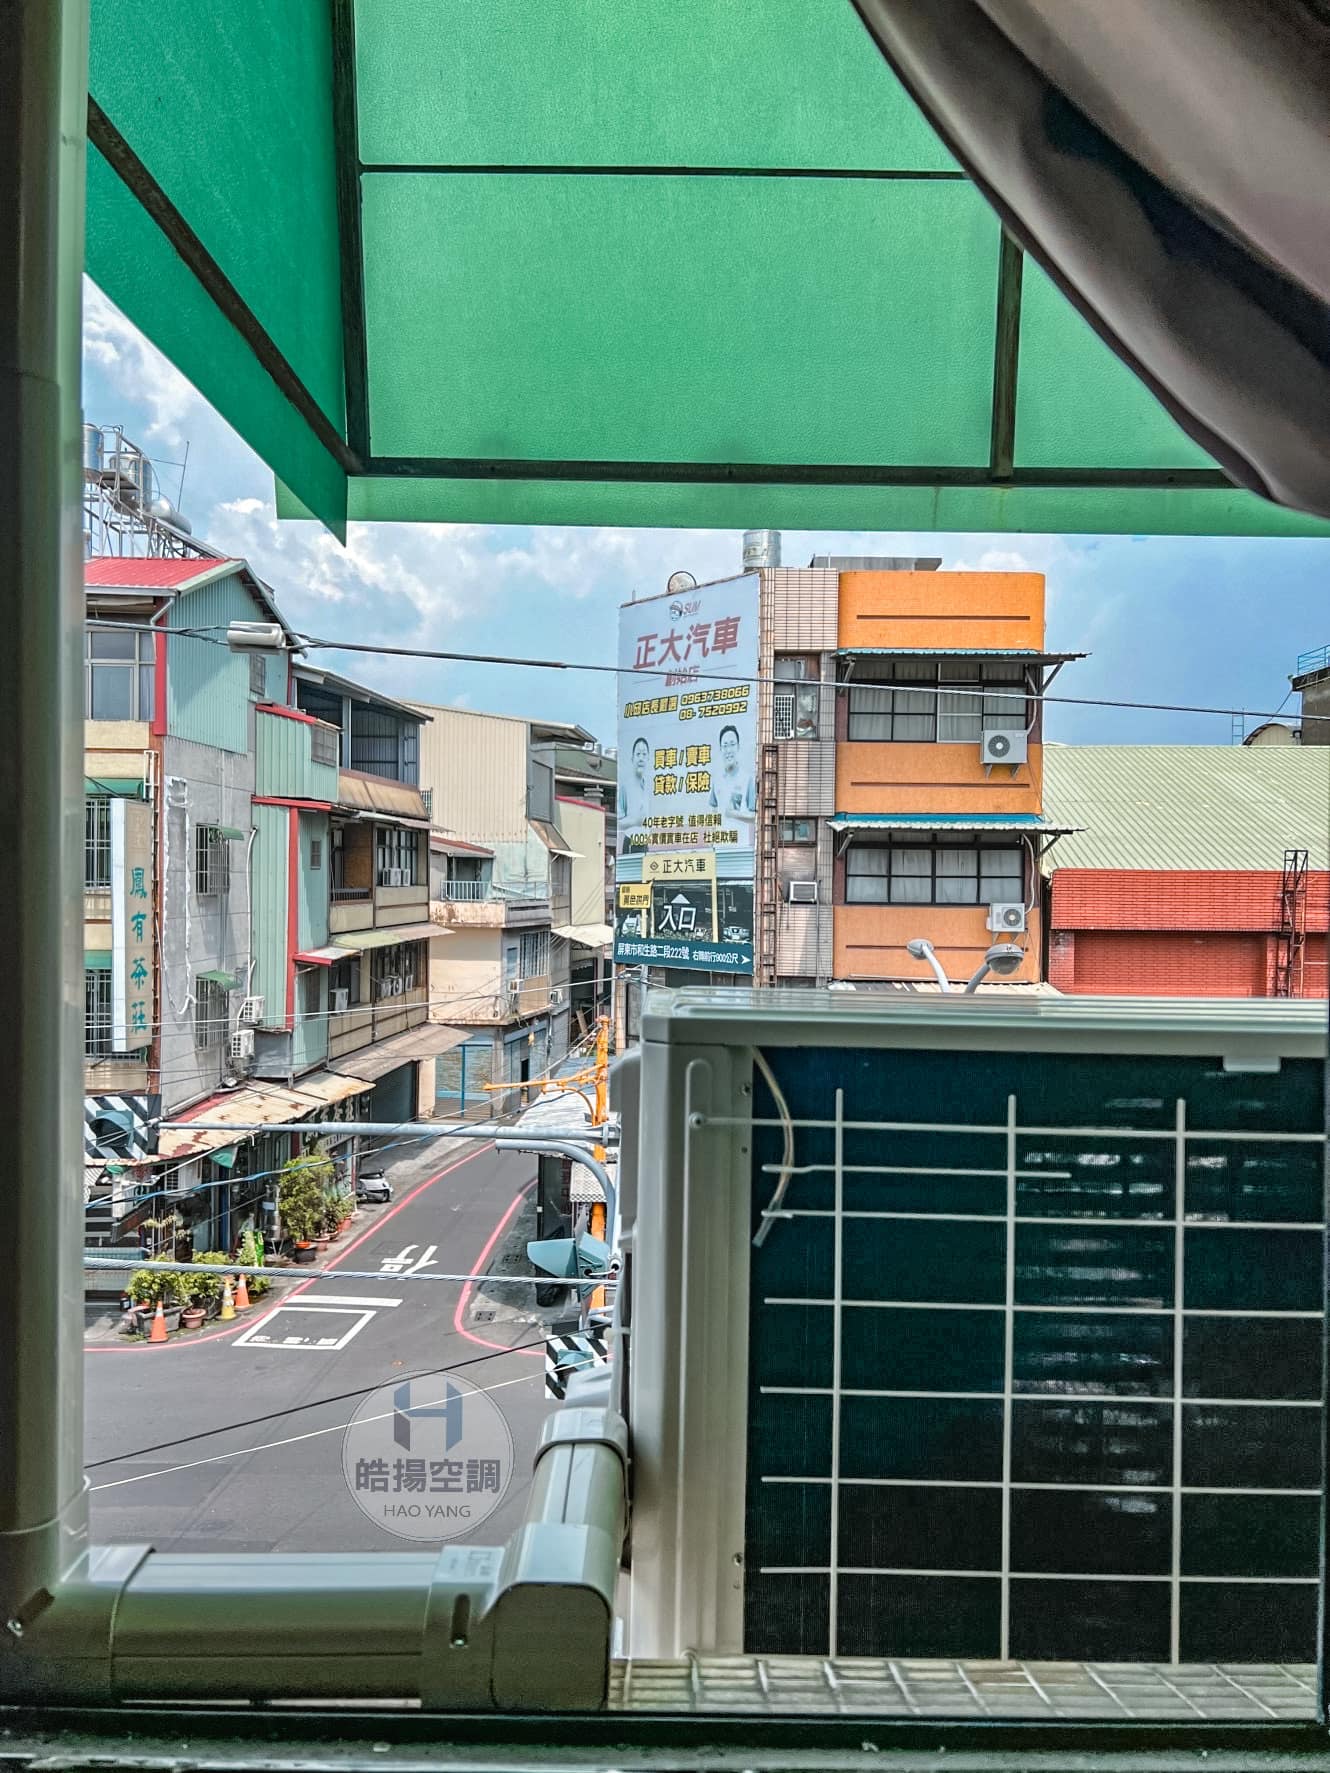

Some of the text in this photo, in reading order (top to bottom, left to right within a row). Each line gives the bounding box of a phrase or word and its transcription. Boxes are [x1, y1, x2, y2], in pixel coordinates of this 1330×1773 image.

[633, 616, 741, 670] 正大汽車
[681, 685, 750, 706] 0963738066
[688, 814, 722, 828] 值得信賴
[663, 858, 706, 874] 正大汽車
[658, 905, 697, 931] 入口
